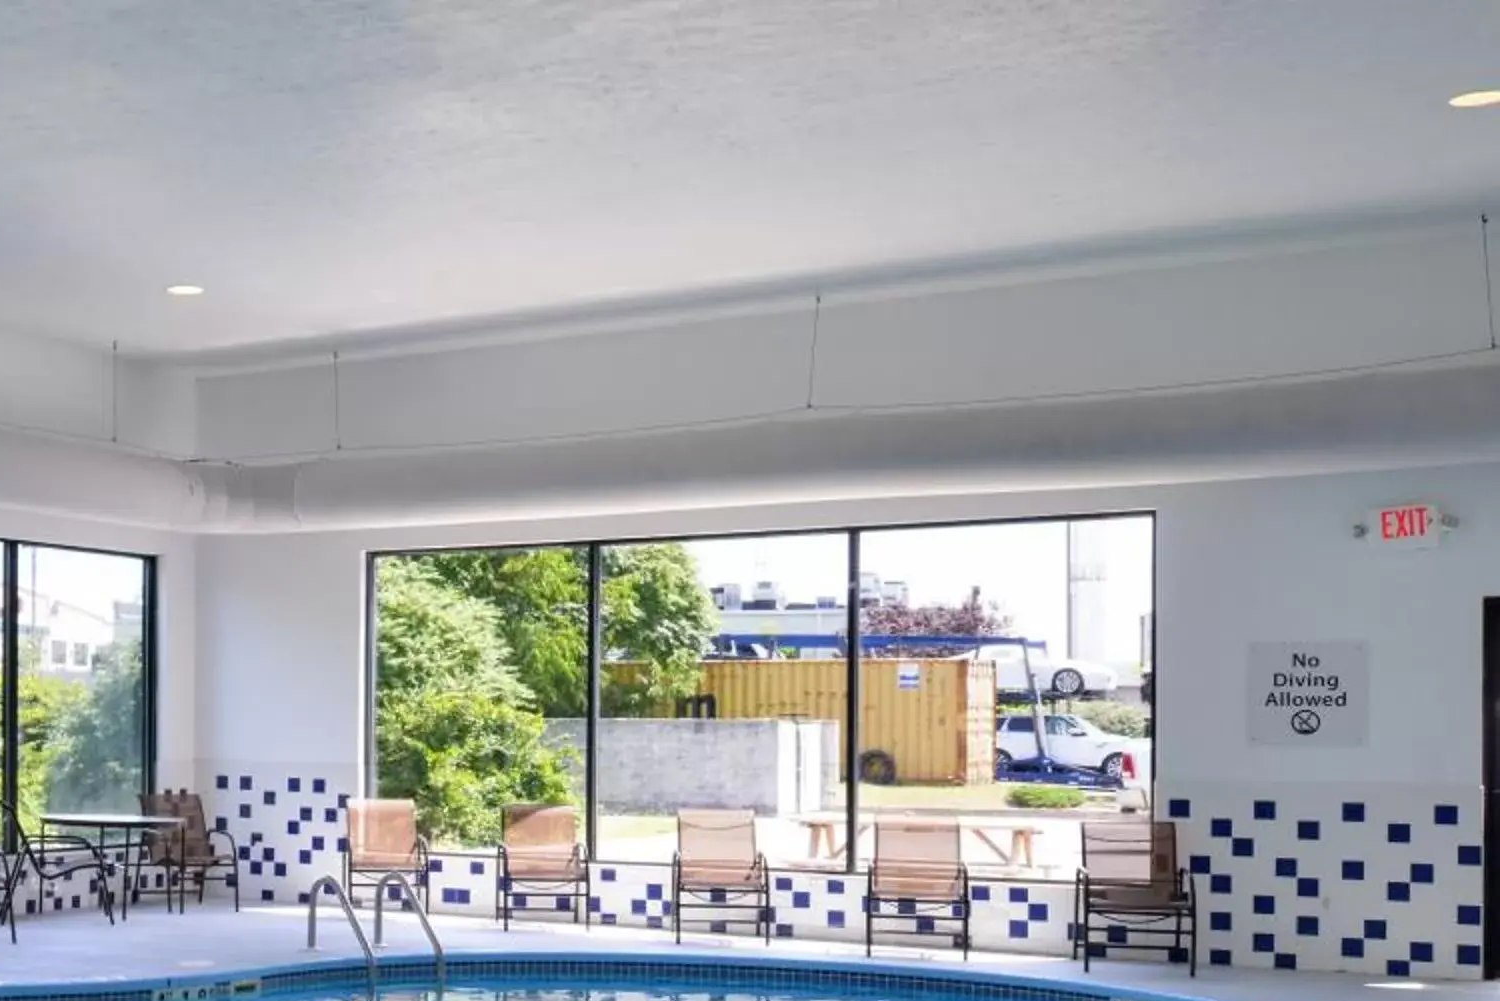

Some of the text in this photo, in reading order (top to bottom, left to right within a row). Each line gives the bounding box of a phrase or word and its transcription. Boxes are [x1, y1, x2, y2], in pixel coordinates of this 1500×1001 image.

[1381, 508, 1428, 539] EXIT
[1292, 653, 1321, 668] No
[1273, 672, 1339, 691] Diving
[1264, 691, 1348, 707] Allowed
